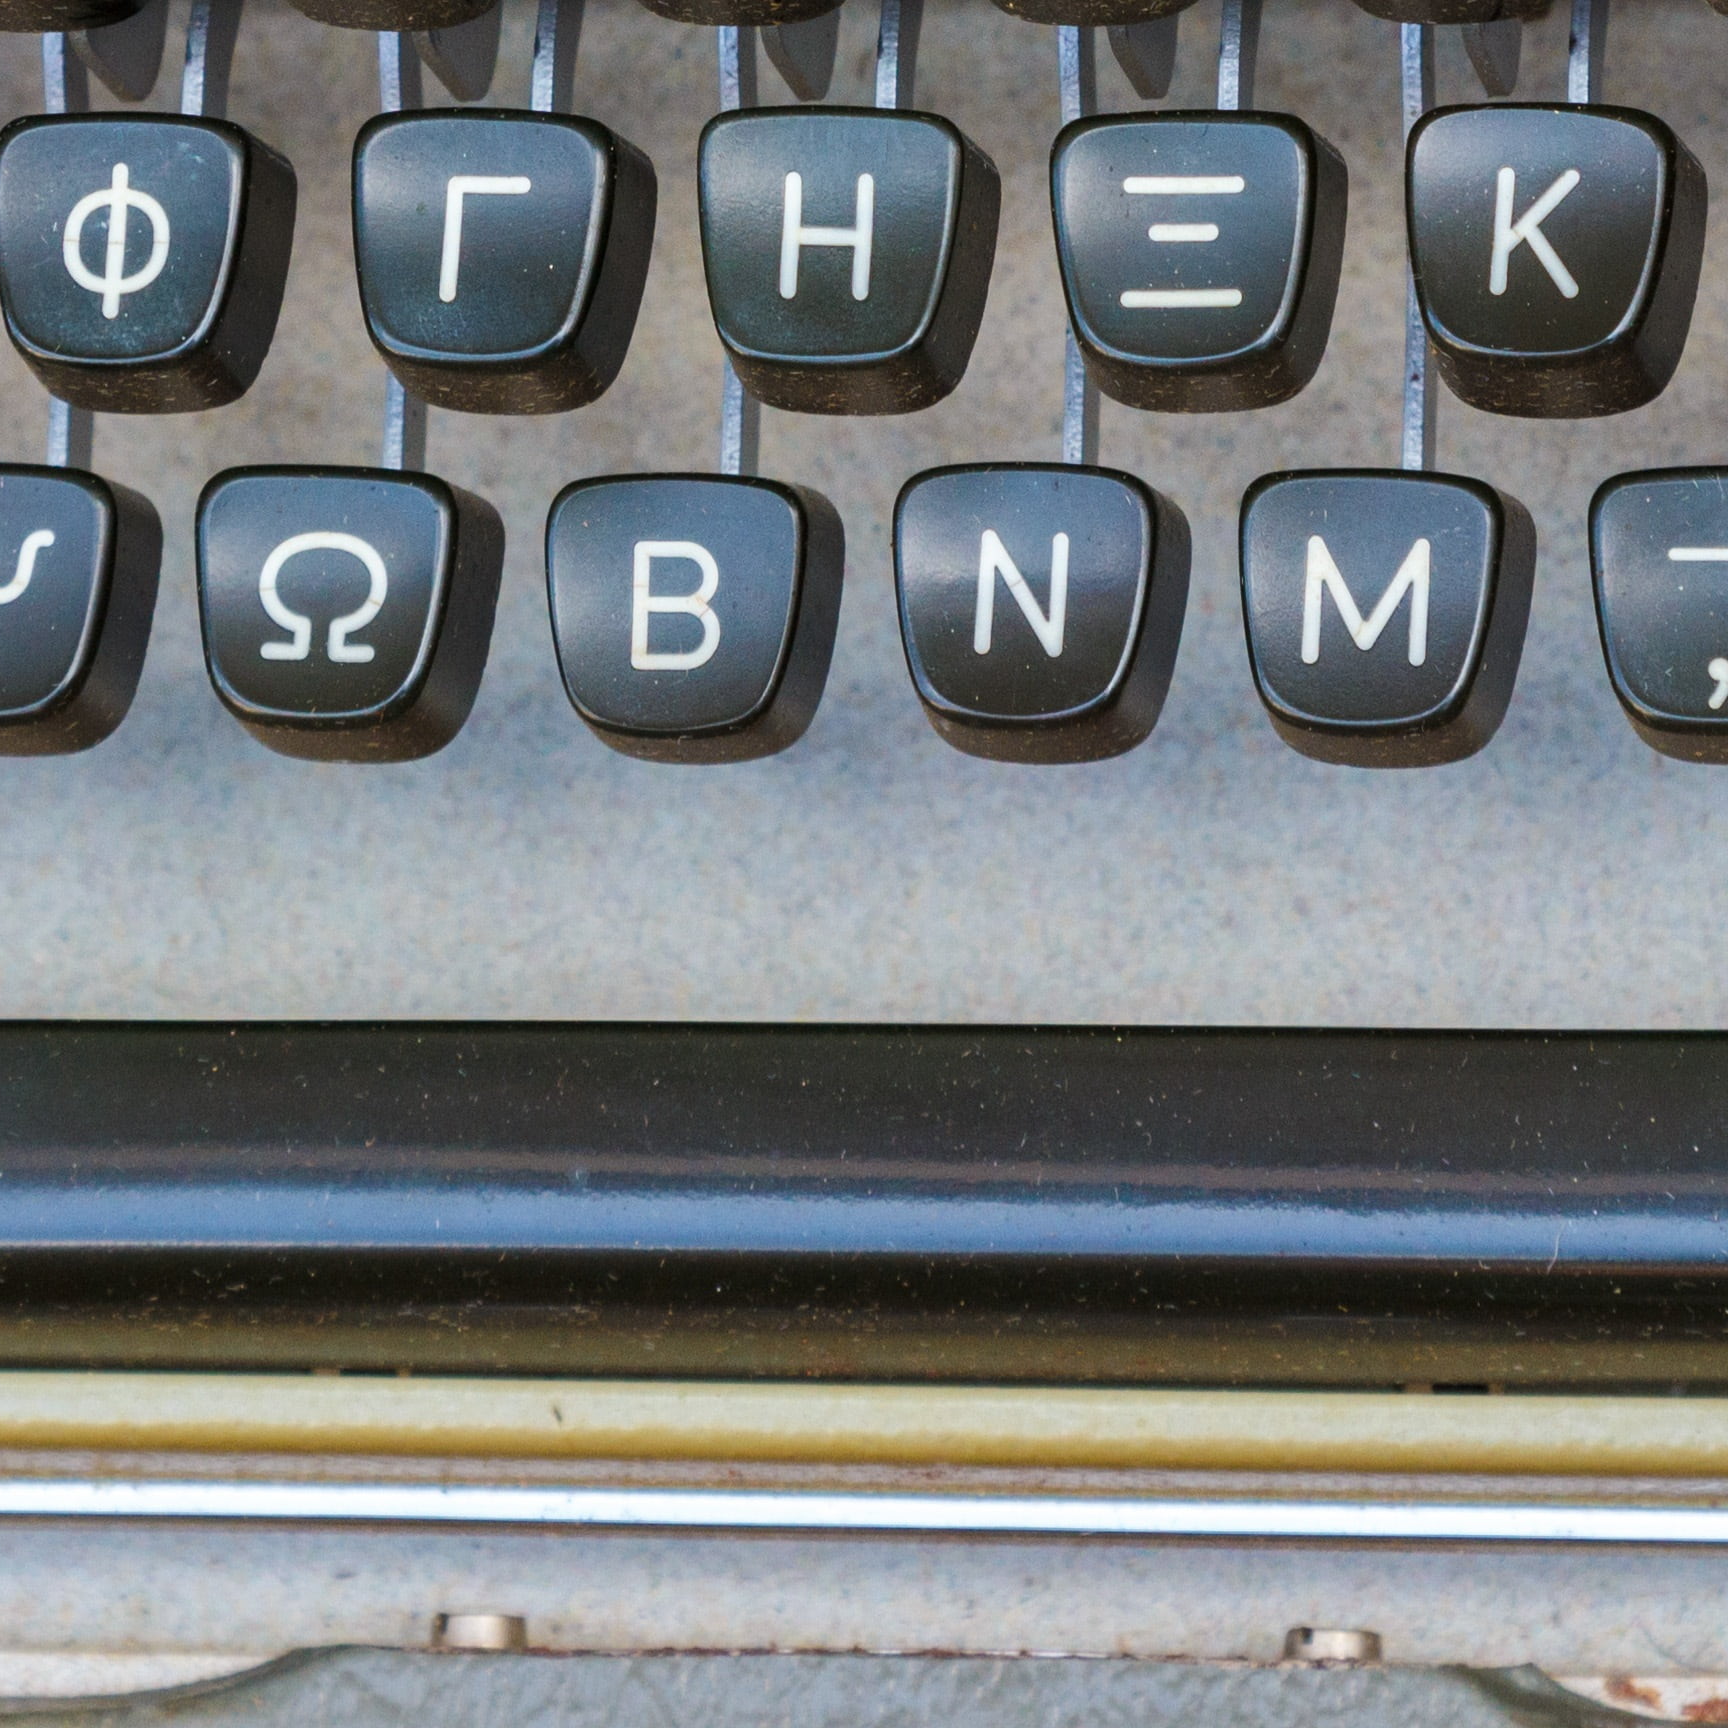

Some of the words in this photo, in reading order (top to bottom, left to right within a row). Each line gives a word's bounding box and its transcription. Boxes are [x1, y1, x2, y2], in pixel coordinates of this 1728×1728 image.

[62, 161, 171, 320] Φ
[438, 174, 533, 303] Γ
[1119, 174, 1246, 309] Ξ
[258, 530, 389, 662] Ω
